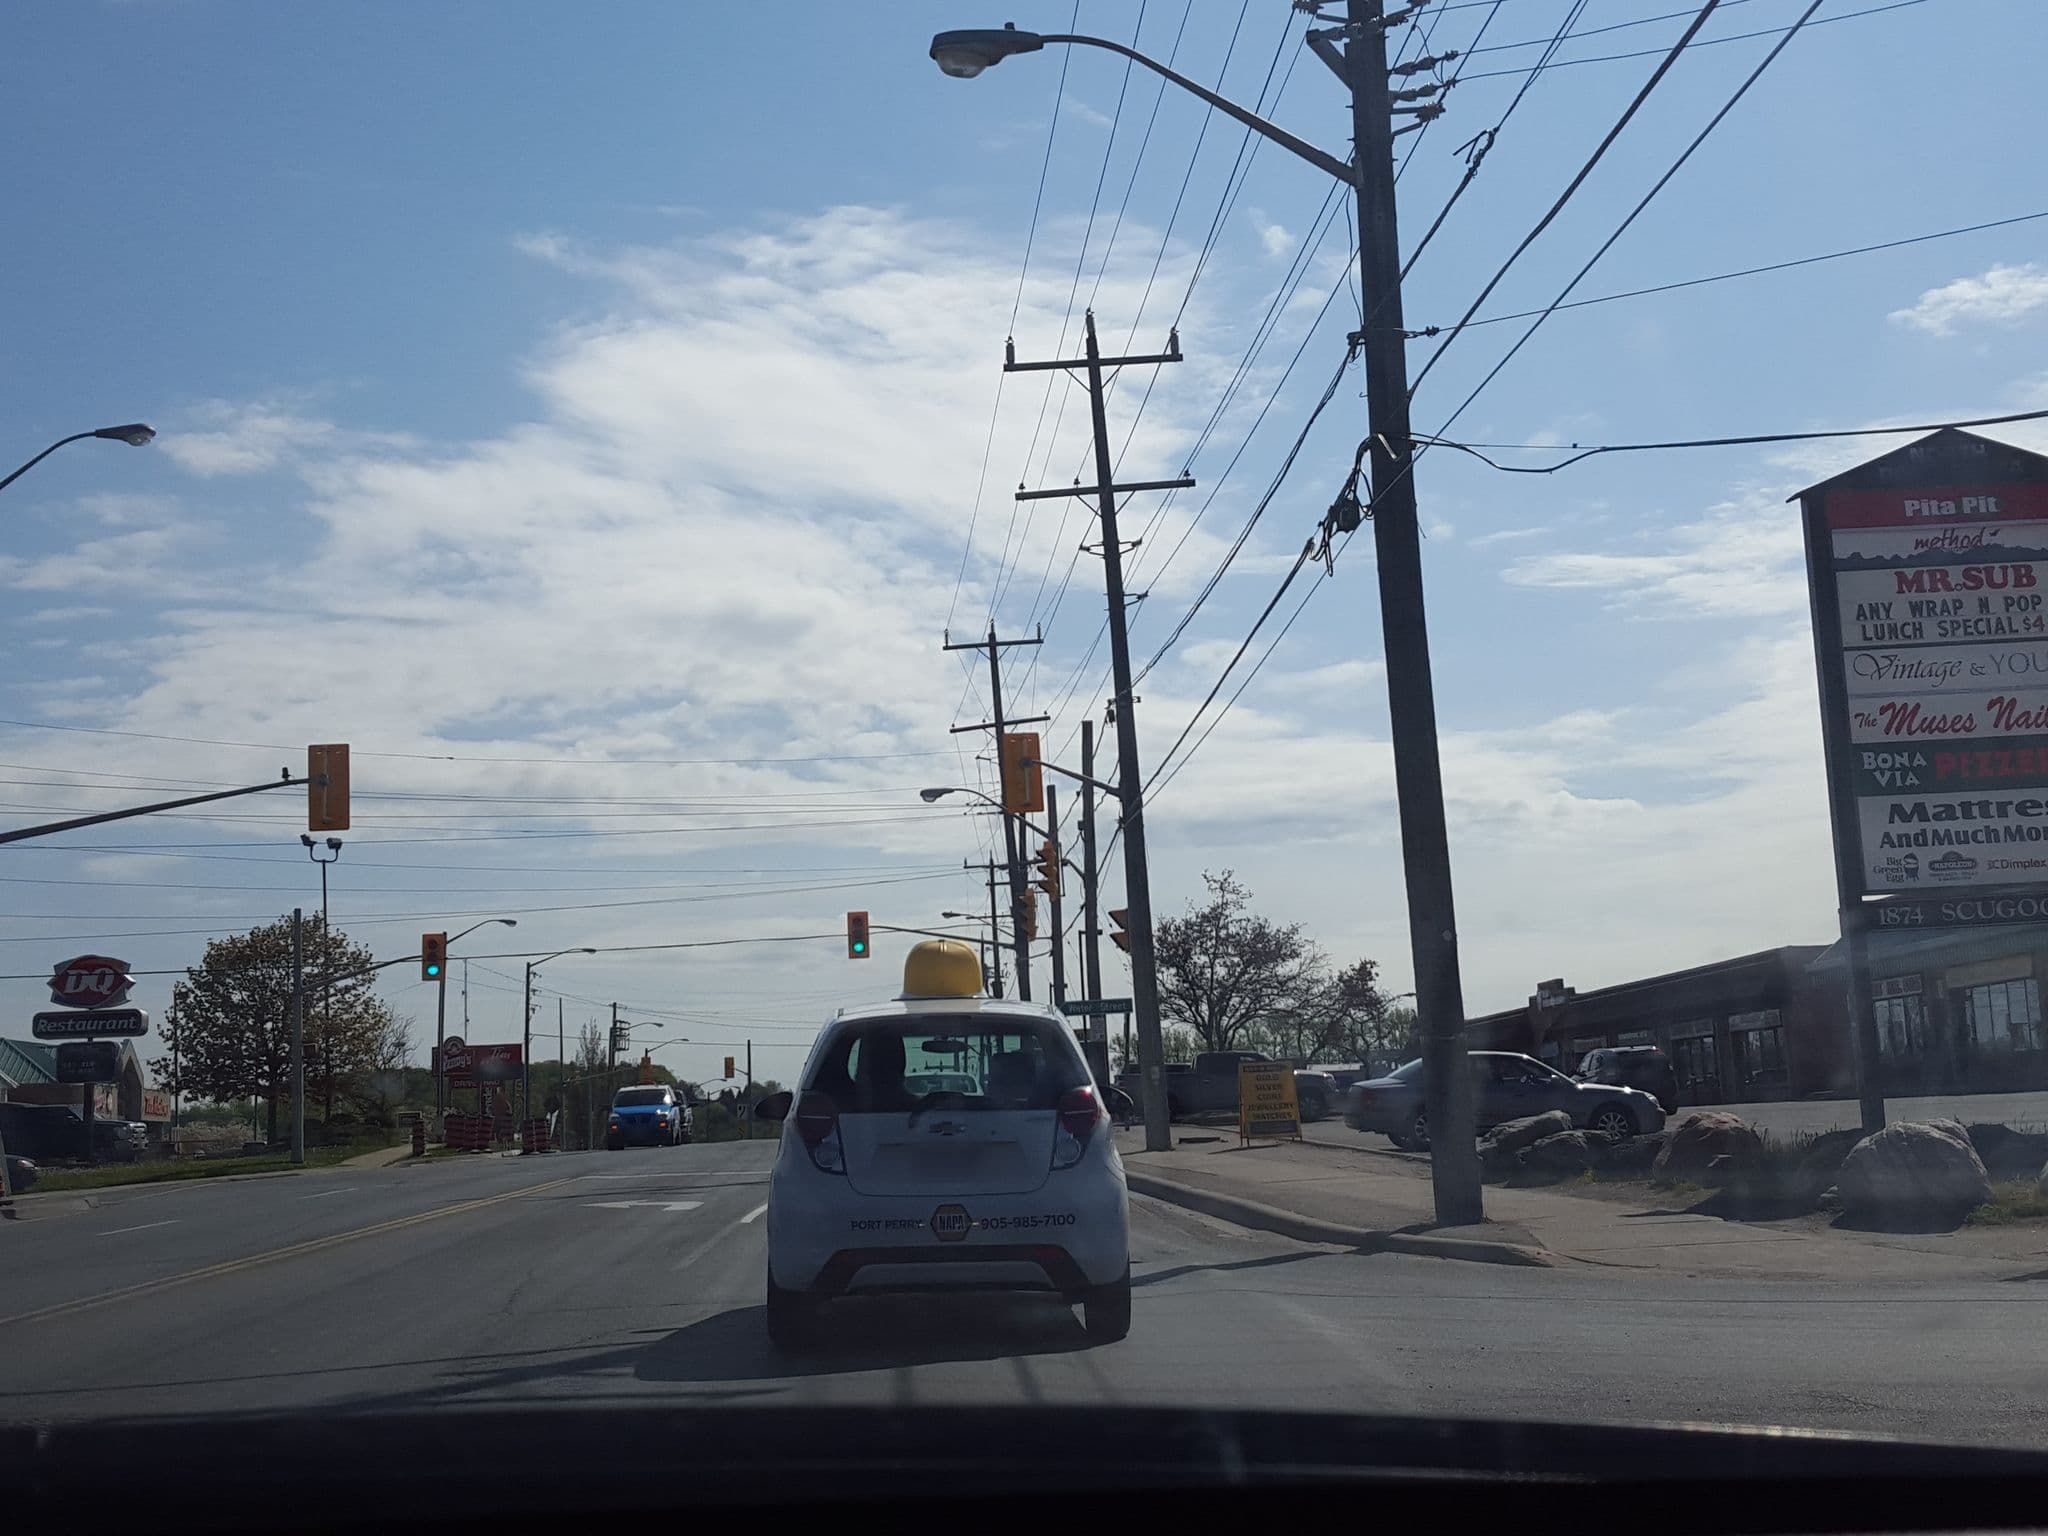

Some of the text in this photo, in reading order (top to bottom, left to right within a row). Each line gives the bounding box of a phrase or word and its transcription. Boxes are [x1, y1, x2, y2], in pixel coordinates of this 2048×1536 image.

[1904, 496, 1999, 517] Pita Pit
[1914, 526, 1986, 550] method
[1855, 594, 2043, 622] ANY WRAP N POP
[1861, 622, 1924, 641] LUNCH
[1937, 617, 2019, 638] SPECIAL
[1853, 653, 1962, 688] Vintage
[1969, 662, 1986, 676] &
[1854, 695, 2048, 736] The Muses Nai
[1861, 751, 1928, 770] BONA
[1888, 799, 2048, 824] Mattre
[1880, 828, 1928, 849] And
[1932, 825, 2000, 846] Much
[2001, 858, 2047, 870] Dimplex
[1879, 904, 1924, 925] 1874
[63, 968, 115, 995] DQ
[1100, 1002, 1127, 1012] Street
[37, 1017, 137, 1033] Restaurant
[851, 1213, 1076, 1231] PORT PERRY NAPA 905-985-7100
